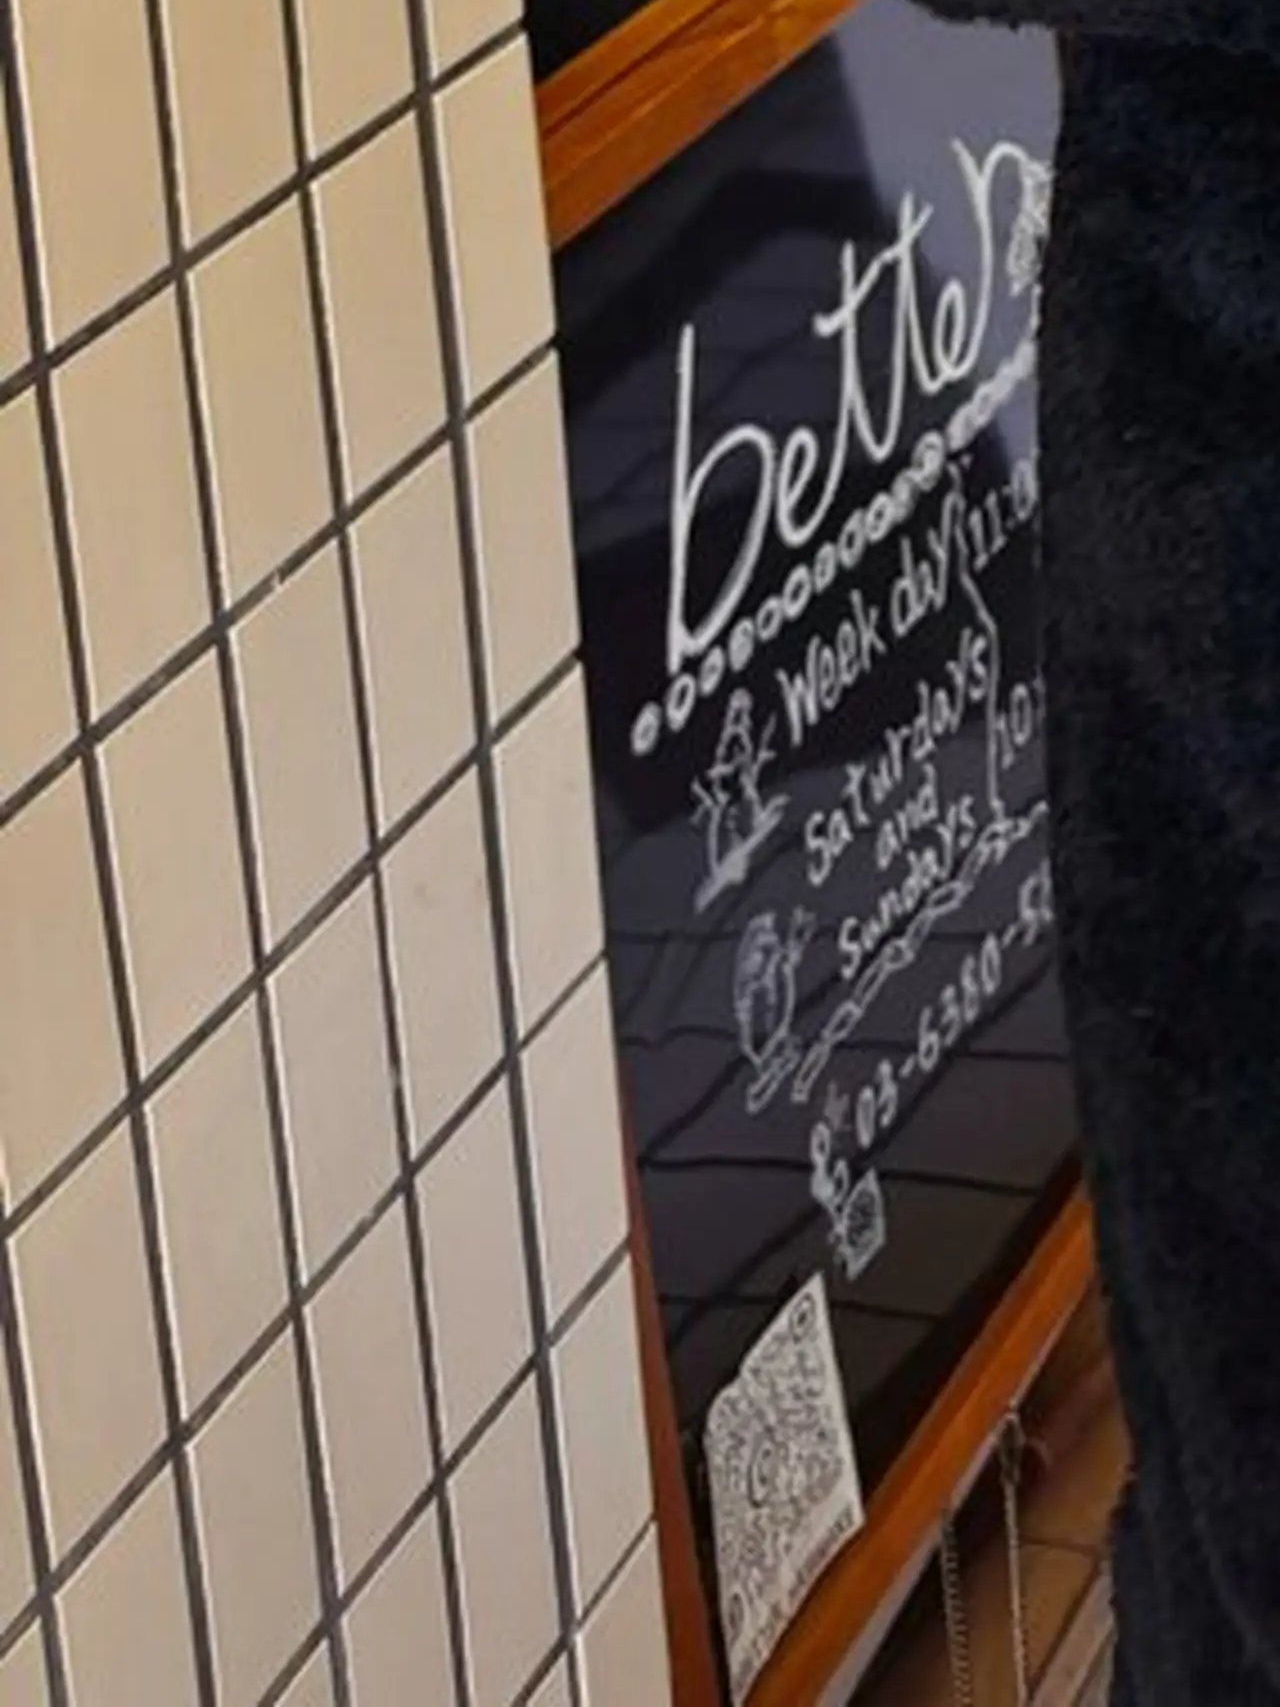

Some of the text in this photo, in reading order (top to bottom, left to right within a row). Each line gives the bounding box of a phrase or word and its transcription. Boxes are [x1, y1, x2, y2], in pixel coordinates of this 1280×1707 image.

[666, 137, 1034, 676] better
[776, 590, 887, 747] Week
[805, 627, 988, 886] Saturdays
[838, 794, 975, 980] Sundays
[876, 763, 939, 871] and
